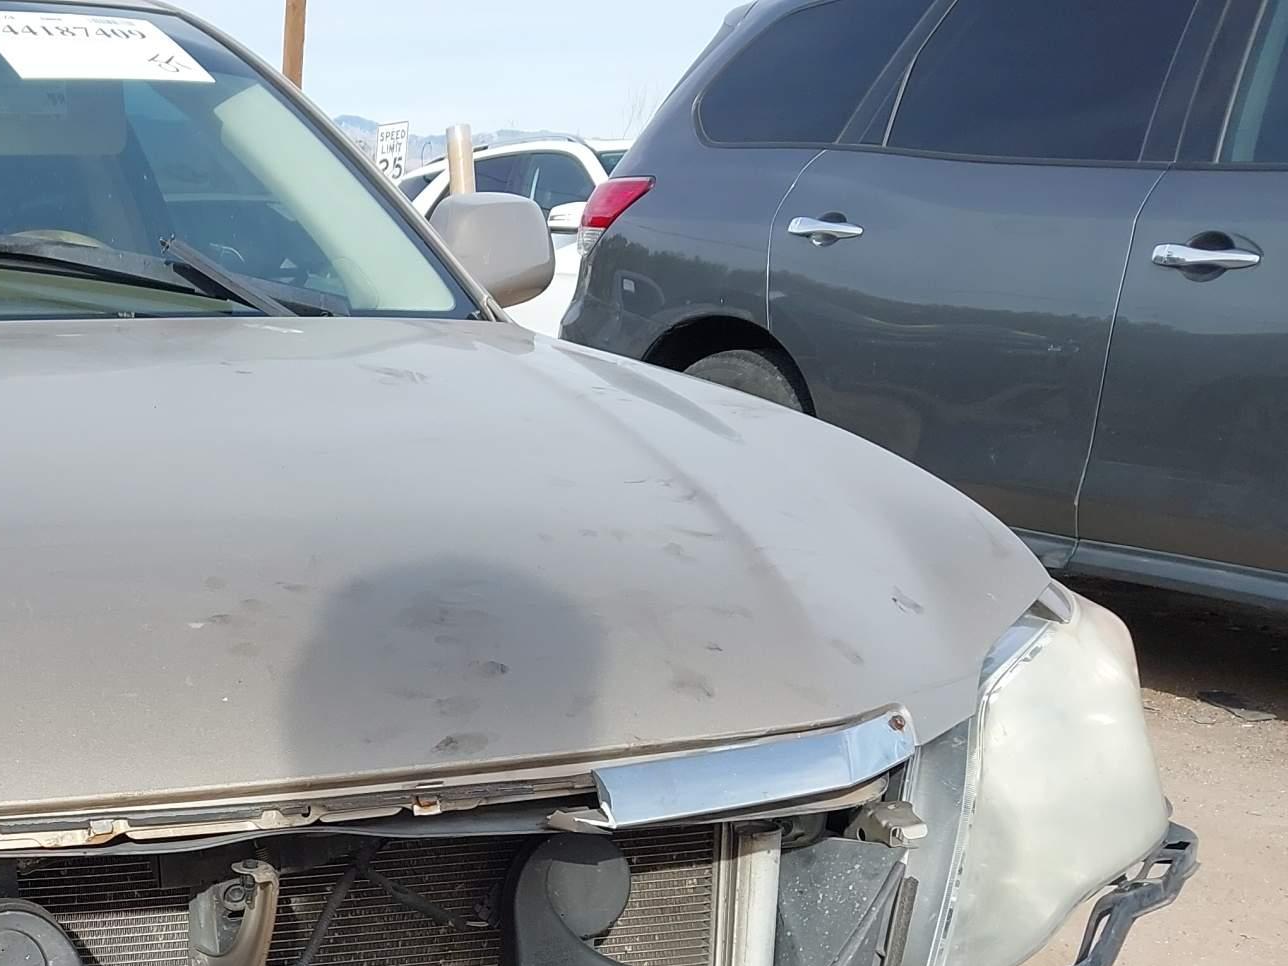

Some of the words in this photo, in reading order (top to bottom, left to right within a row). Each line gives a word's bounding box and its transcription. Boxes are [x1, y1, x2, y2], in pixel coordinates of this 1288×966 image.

[2, 24, 147, 40] 44187409
[380, 129, 406, 142] SPEED
[381, 142, 403, 154] LIMIT
